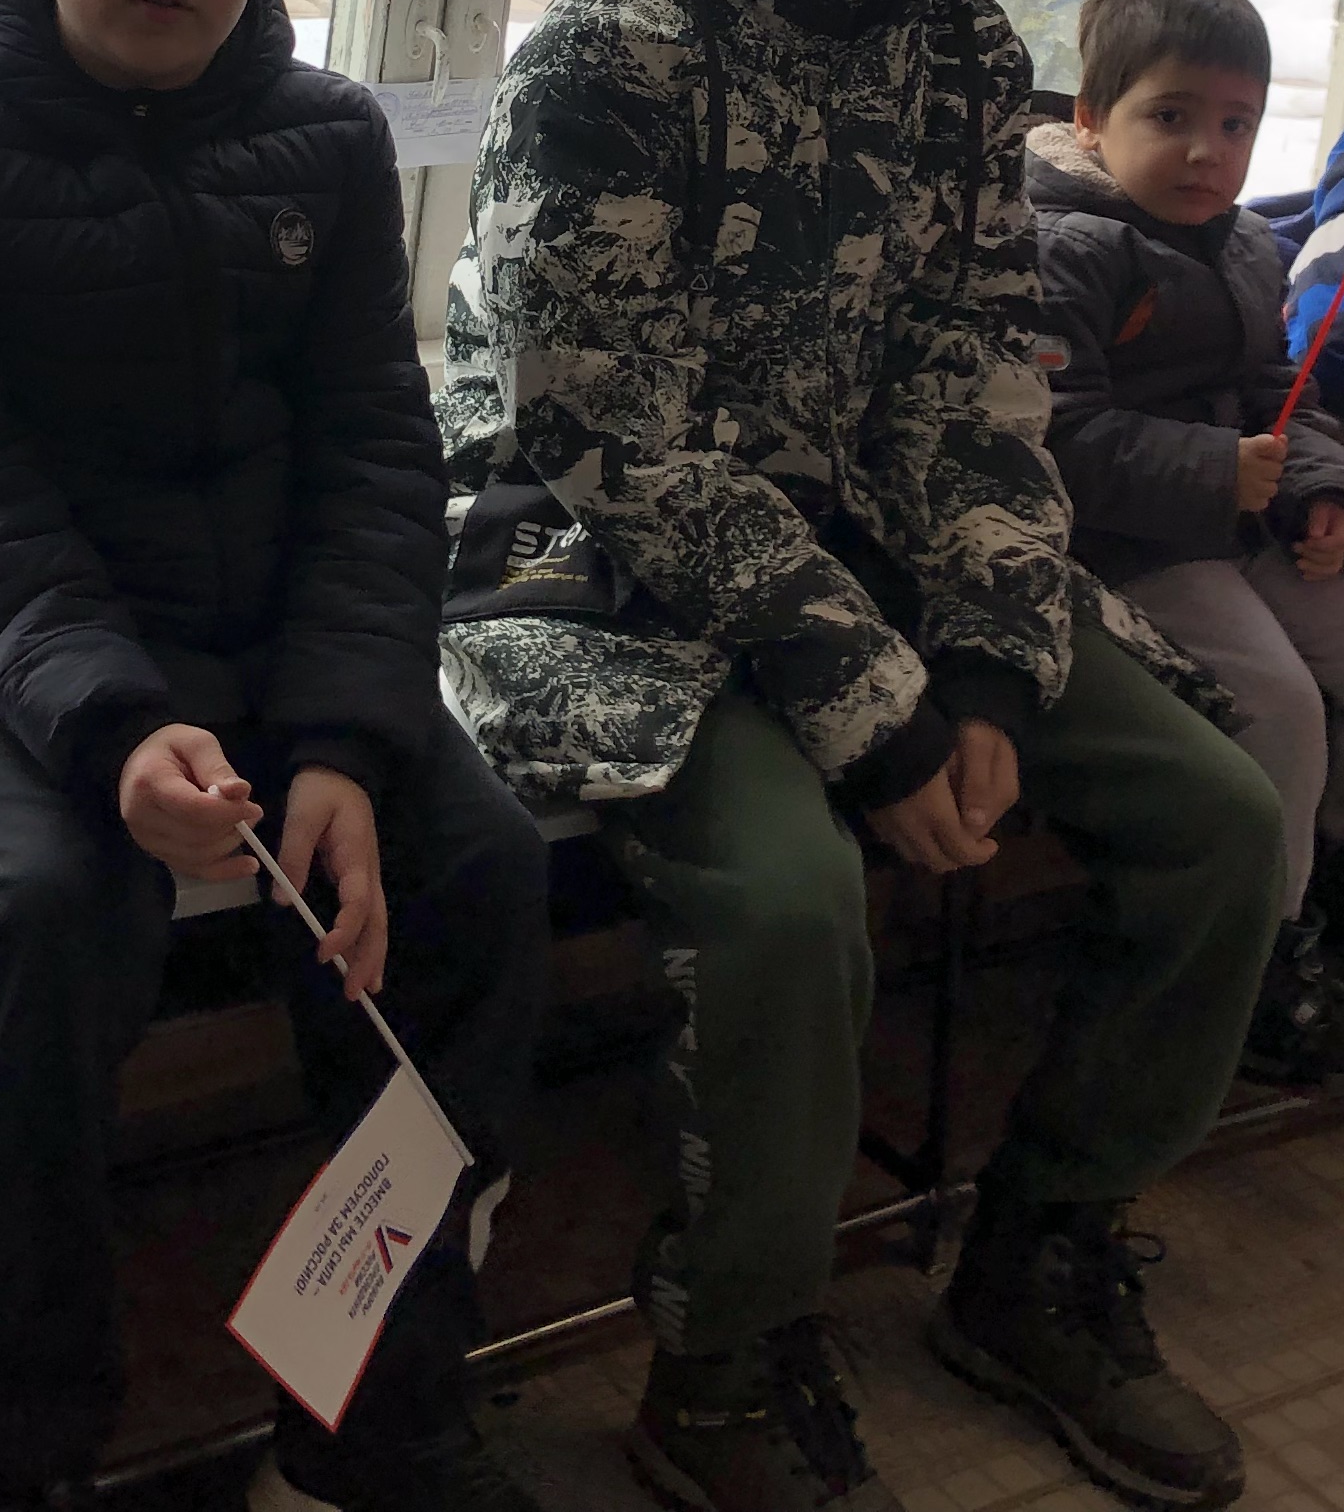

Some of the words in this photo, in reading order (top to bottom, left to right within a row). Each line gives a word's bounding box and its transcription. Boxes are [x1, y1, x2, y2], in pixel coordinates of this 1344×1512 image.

[338, 1152, 390, 1221] ГОЛОСУЕМ
[352, 1176, 392, 1229] ВМЕСТЕ
[326, 1214, 343, 1238] ЗА
[337, 1223, 358, 1254] МЫ
[316, 1248, 342, 1289] СИЛА
